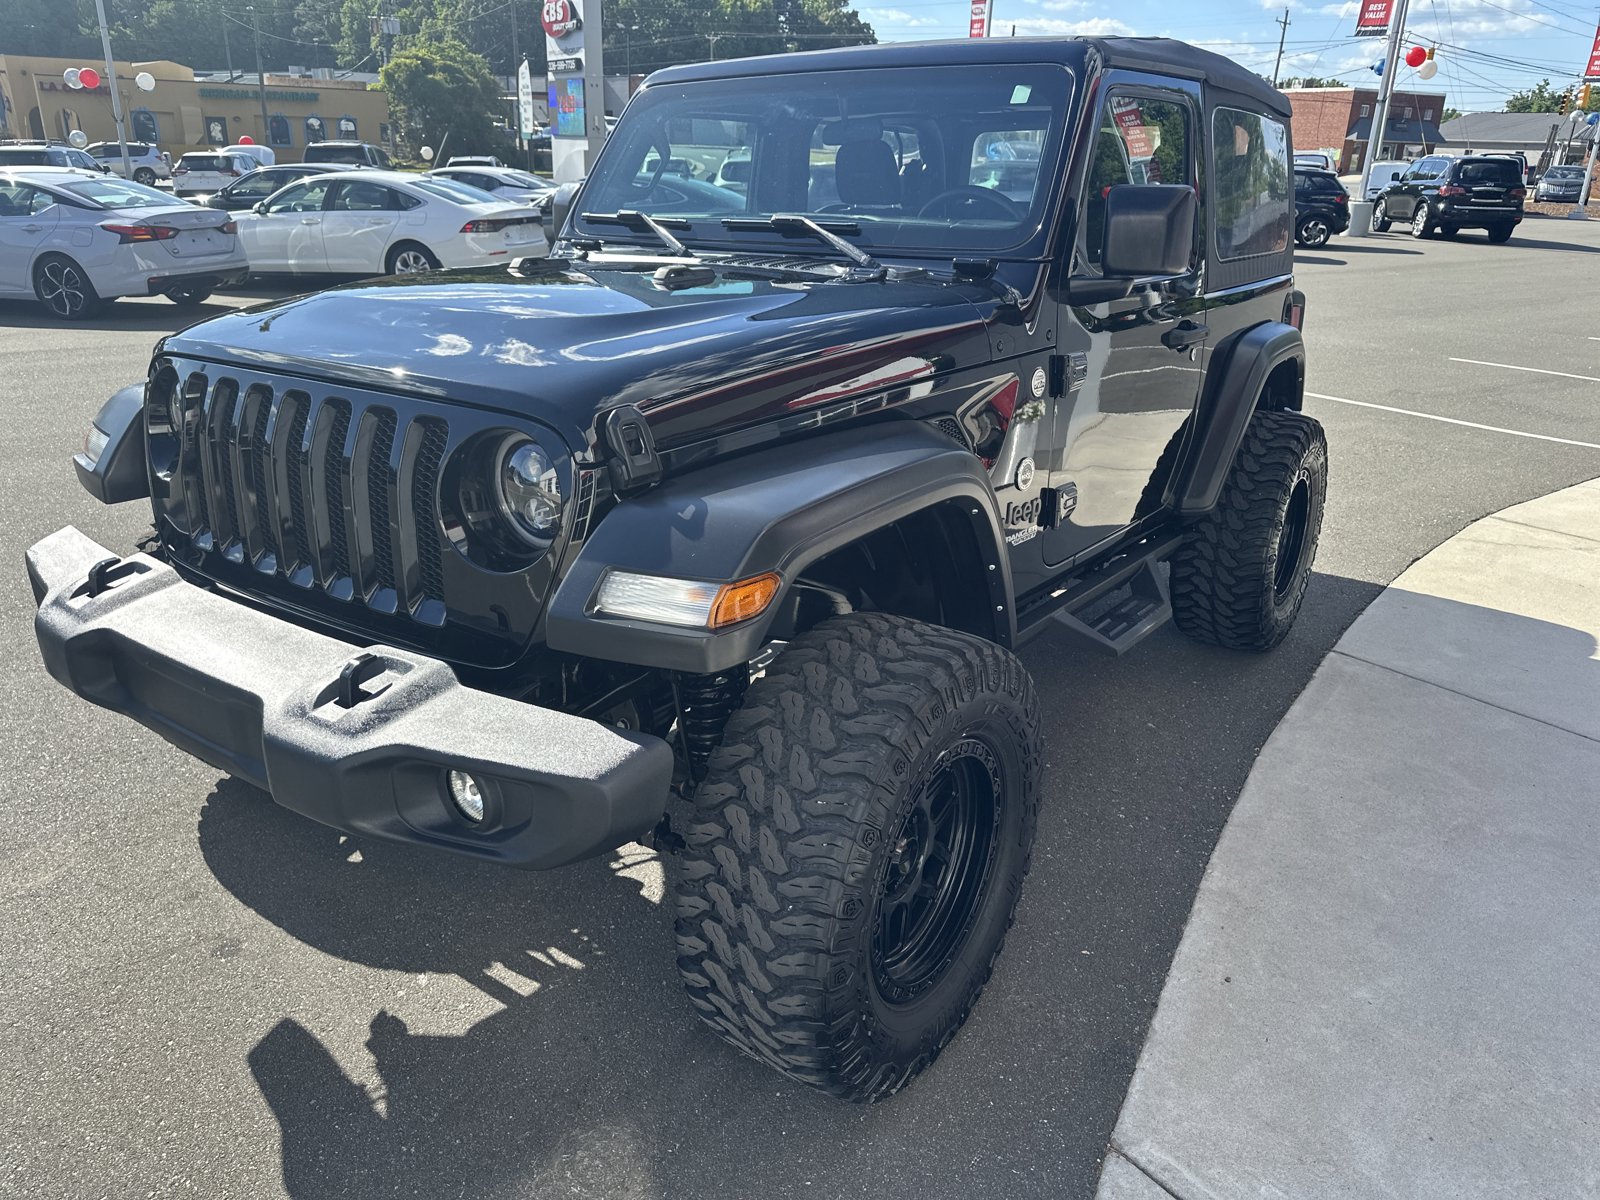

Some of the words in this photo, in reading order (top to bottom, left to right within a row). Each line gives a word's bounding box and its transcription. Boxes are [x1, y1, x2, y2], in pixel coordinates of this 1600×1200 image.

[1369, 3, 1387, 11] BEST
[1365, 11, 1386, 19] VALUE
[1004, 497, 1042, 528] Jeep
[1005, 525, 1038, 543] RANGLER
